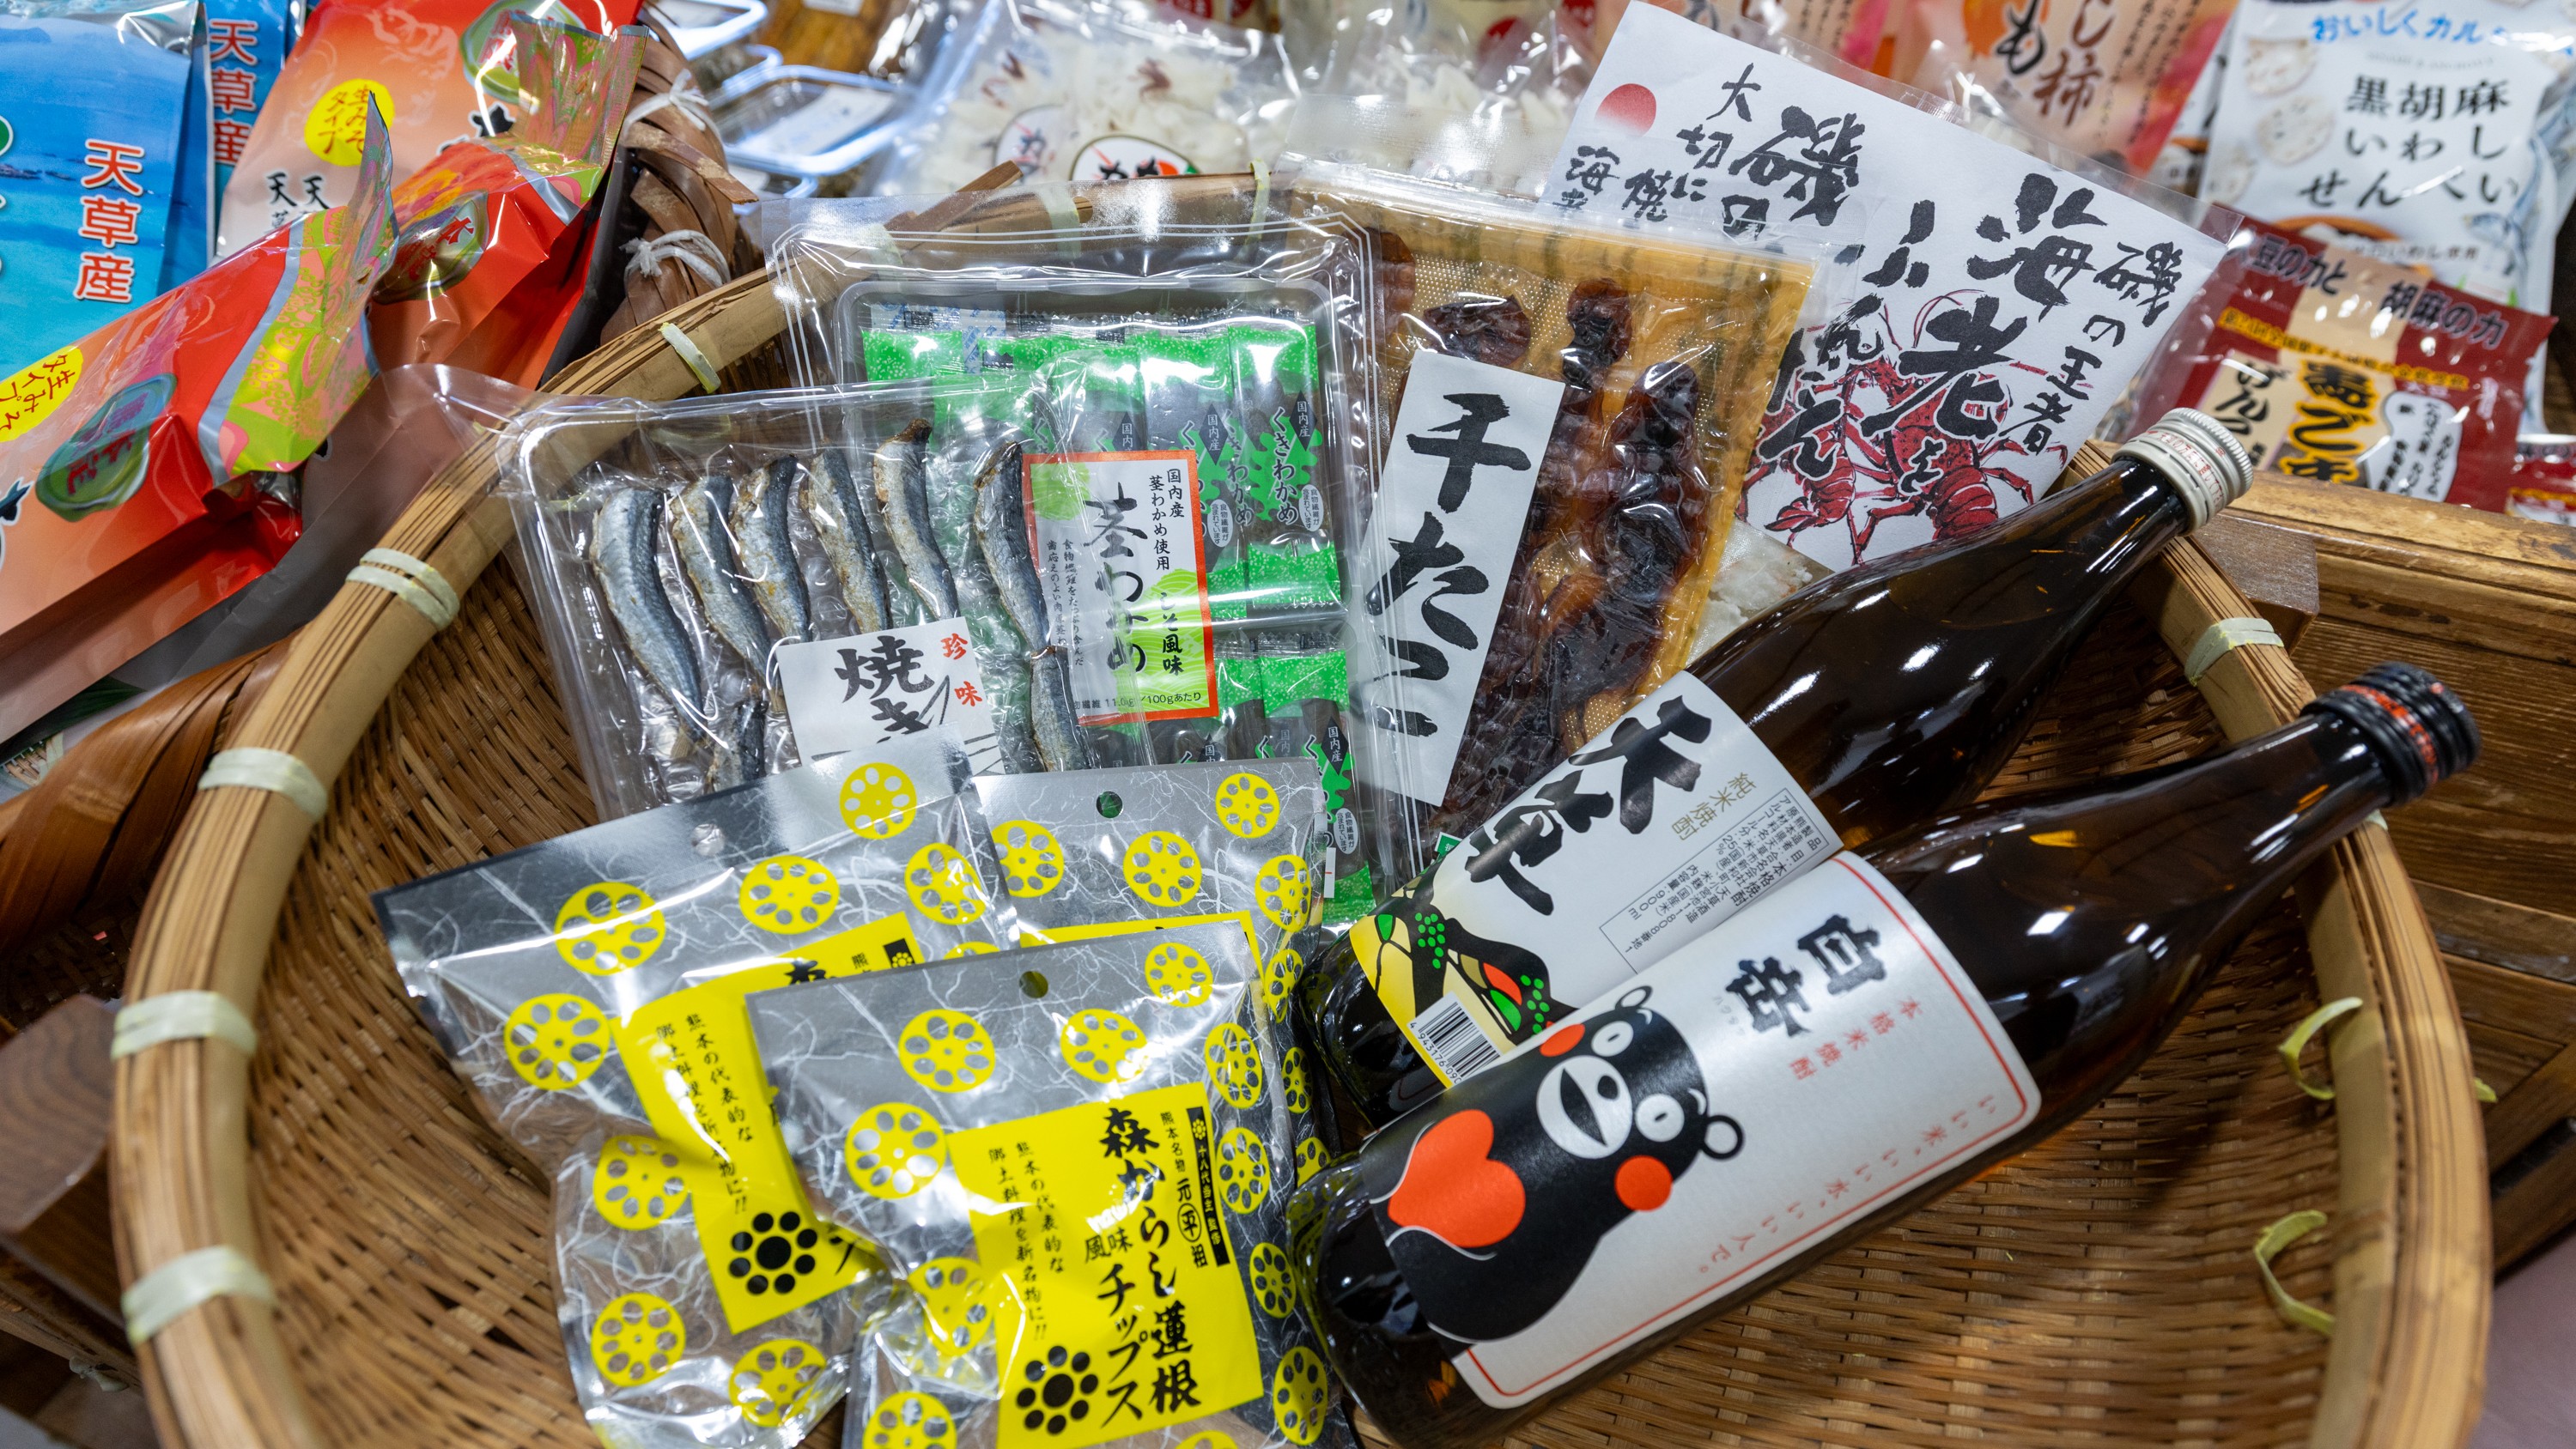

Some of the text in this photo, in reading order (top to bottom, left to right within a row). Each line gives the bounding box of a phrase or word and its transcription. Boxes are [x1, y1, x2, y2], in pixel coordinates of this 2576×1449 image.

[210, 19, 258, 164] 天草産
[1671, 64, 1762, 202] 大切に
[2345, 76, 2511, 121] 黒胡麻
[2345, 125, 2507, 161] いわし
[76, 138, 145, 304] 天草産
[2237, 230, 2348, 296] 豆の力と
[1999, 241, 2183, 456] 磯の王者
[1122, 422, 1134, 451] 国内
[1208, 414, 1221, 452] 国内産
[1297, 400, 1311, 438] 国内産
[1166, 469, 1184, 518] 国内産
[1270, 406, 1299, 525] くきわかめ
[1149, 476, 1170, 571] 茎わかめ使用
[1365, 392, 1532, 737] 干たこ
[1083, 481, 1149, 673] 茎わかめ
[940, 633, 983, 706] 珍味
[1328, 726, 1342, 762] 国内産
[1465, 694, 1711, 916] 天草
[1671, 772, 1756, 842] 純米焼酎
[1684, 885, 1733, 925] 天草酒造
[685, 1014, 753, 1143] 熊本の代表的な
[1418, 1032, 1447, 1069] 943176
[1786, 994, 1926, 1084] 本格米焼酎
[656, 1022, 748, 1215] 郷土料理を新物に!!
[1161, 1112, 1186, 1173] 熊本名物
[1017, 1142, 1064, 1273] 熊本の代表的な
[1085, 1228, 1133, 1264] 風味
[1099, 1107, 1200, 1413] 森からし蓮根
[1097, 1264, 1149, 1428] チップス
